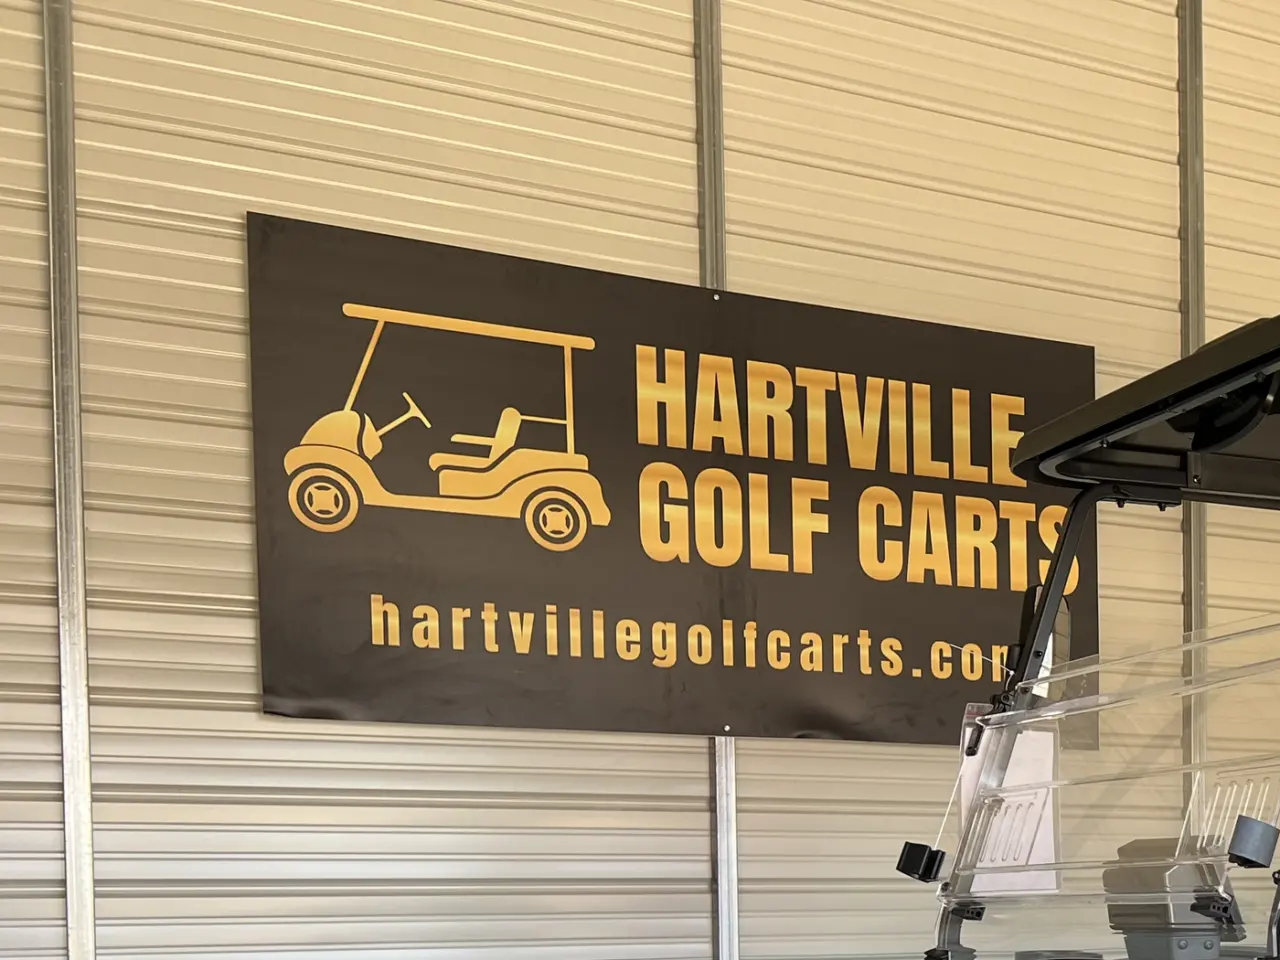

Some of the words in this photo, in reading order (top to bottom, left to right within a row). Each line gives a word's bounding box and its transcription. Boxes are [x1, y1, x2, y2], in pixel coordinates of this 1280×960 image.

[635, 344, 1027, 488] HARTVILLE
[638, 461, 830, 574] GOLF
[858, 485, 1080, 596] CARTS
